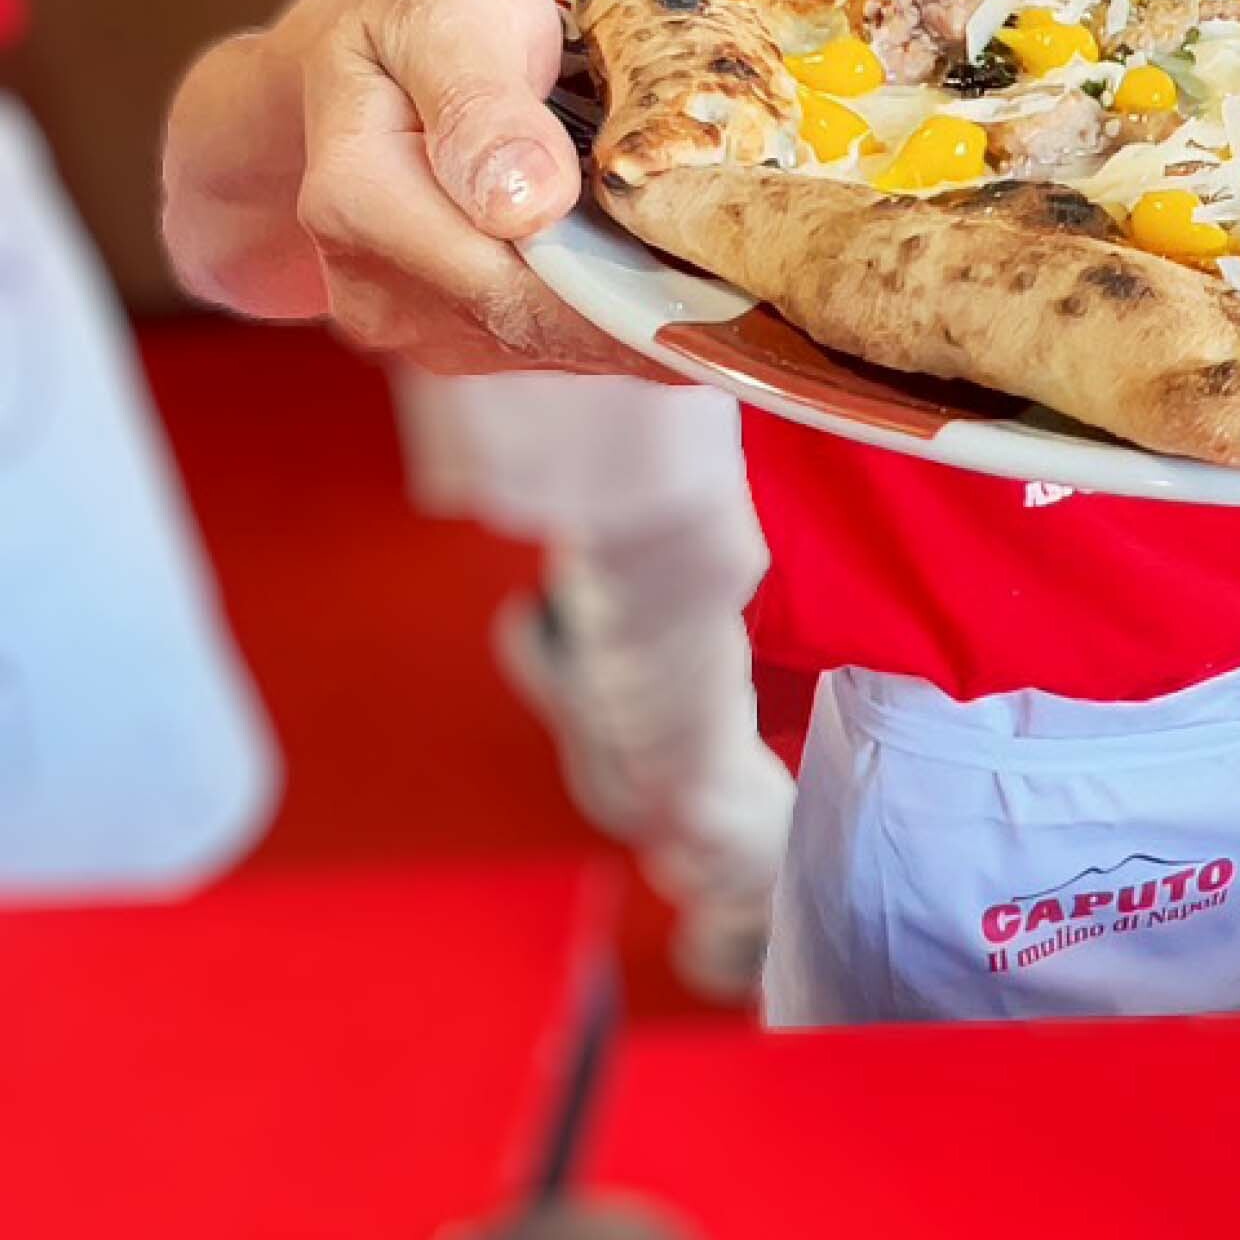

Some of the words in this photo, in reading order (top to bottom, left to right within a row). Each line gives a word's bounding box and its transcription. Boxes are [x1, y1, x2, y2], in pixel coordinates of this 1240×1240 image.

[981, 857, 1234, 944] CAPUTO
[987, 948, 1008, 974] Il
[1017, 923, 1104, 968] mulino
[1112, 913, 1139, 933] di
[1149, 889, 1229, 930] Napoli
